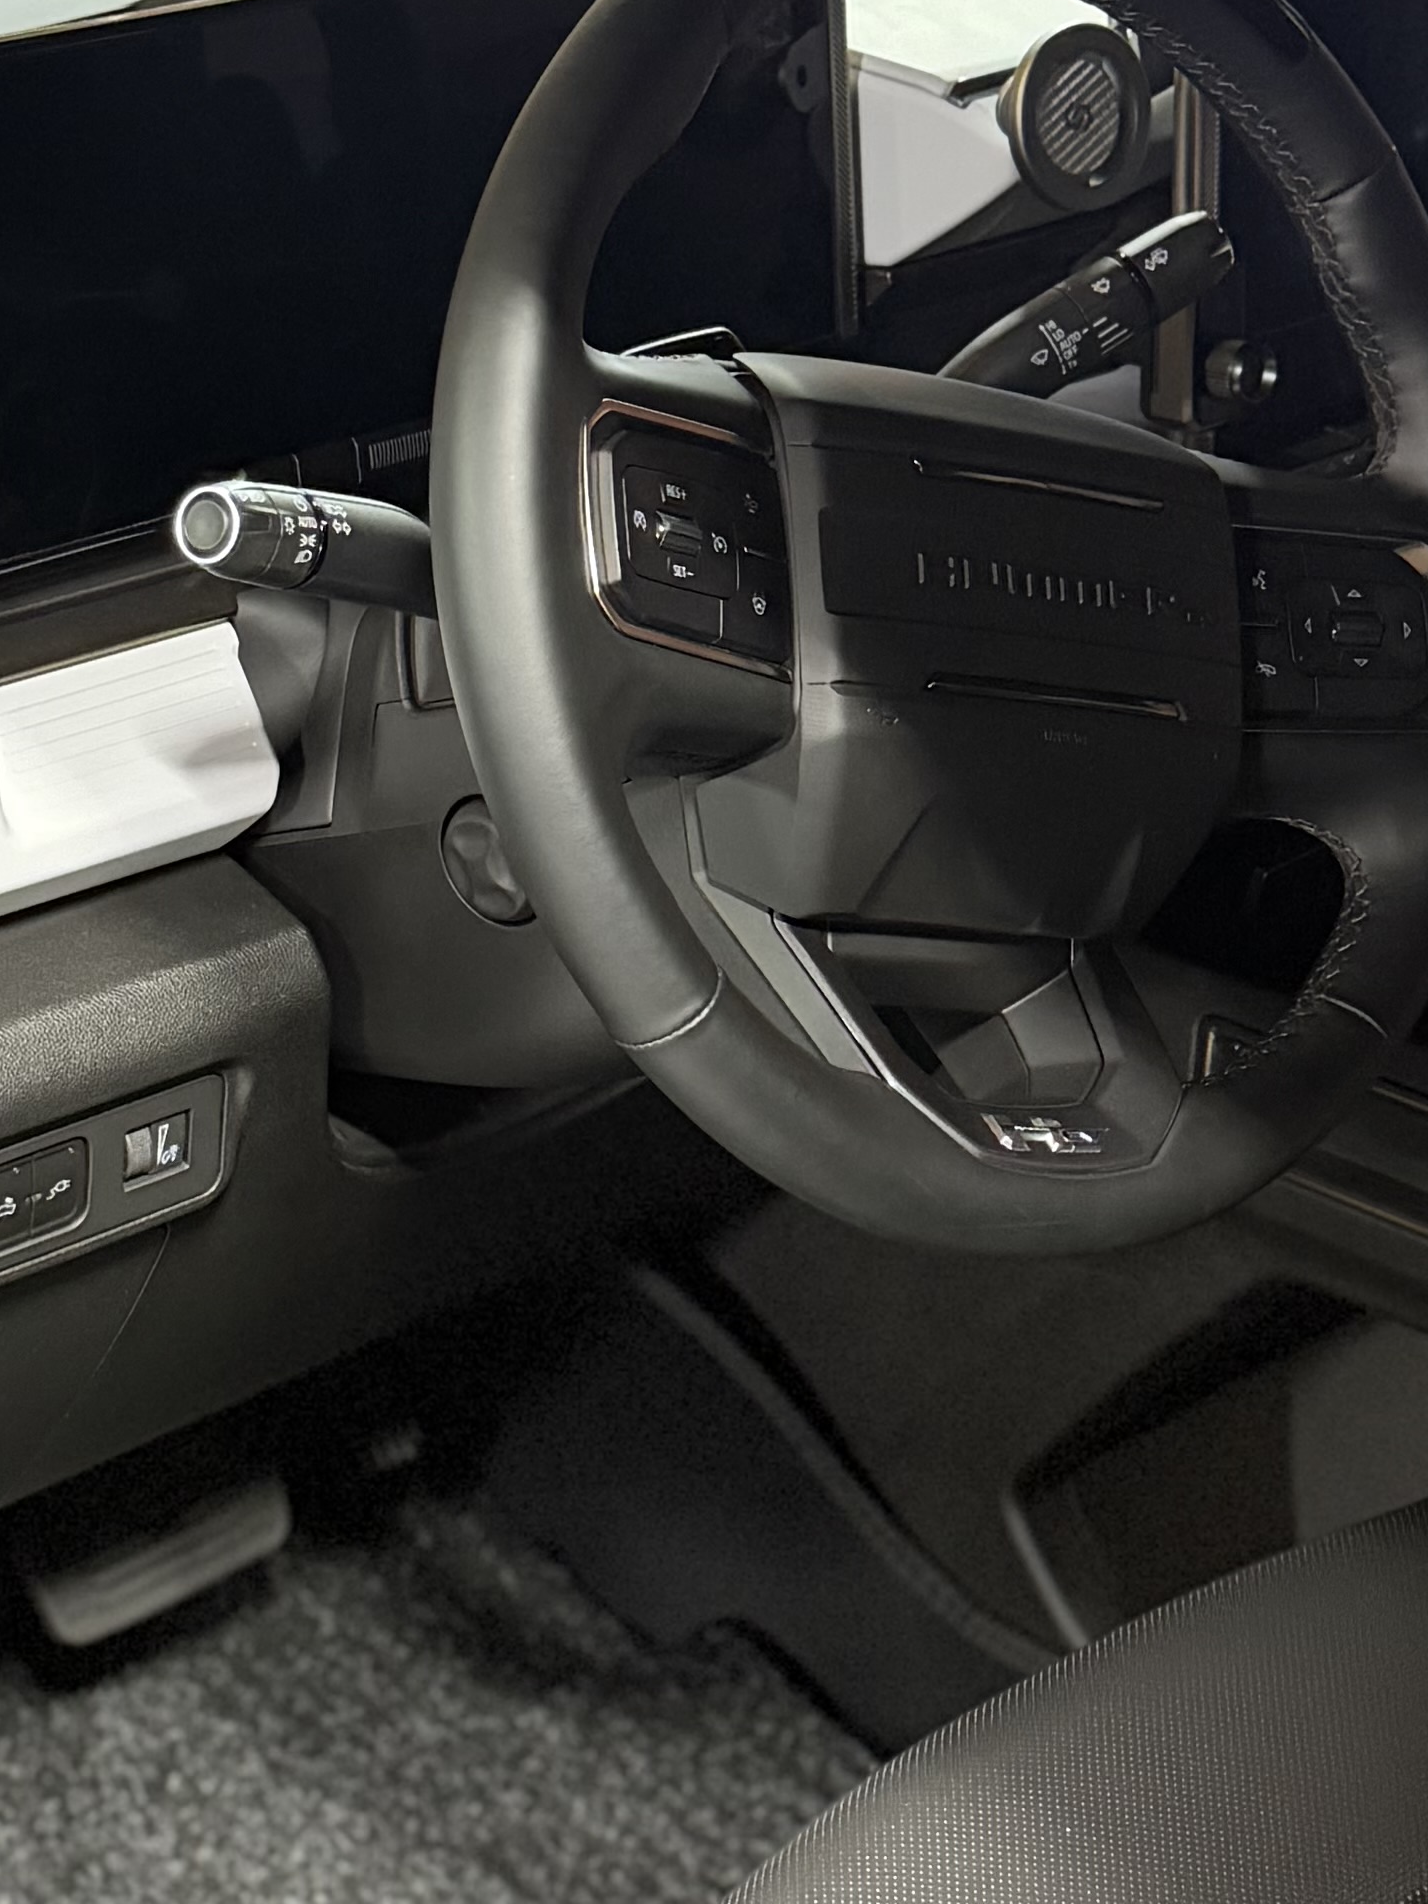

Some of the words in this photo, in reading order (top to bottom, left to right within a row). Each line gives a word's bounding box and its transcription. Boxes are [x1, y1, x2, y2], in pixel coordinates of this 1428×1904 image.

[1060, 330, 1082, 351] AUTO
[1063, 344, 1078, 360] OFF
[298, 516, 318, 528] AUTO
